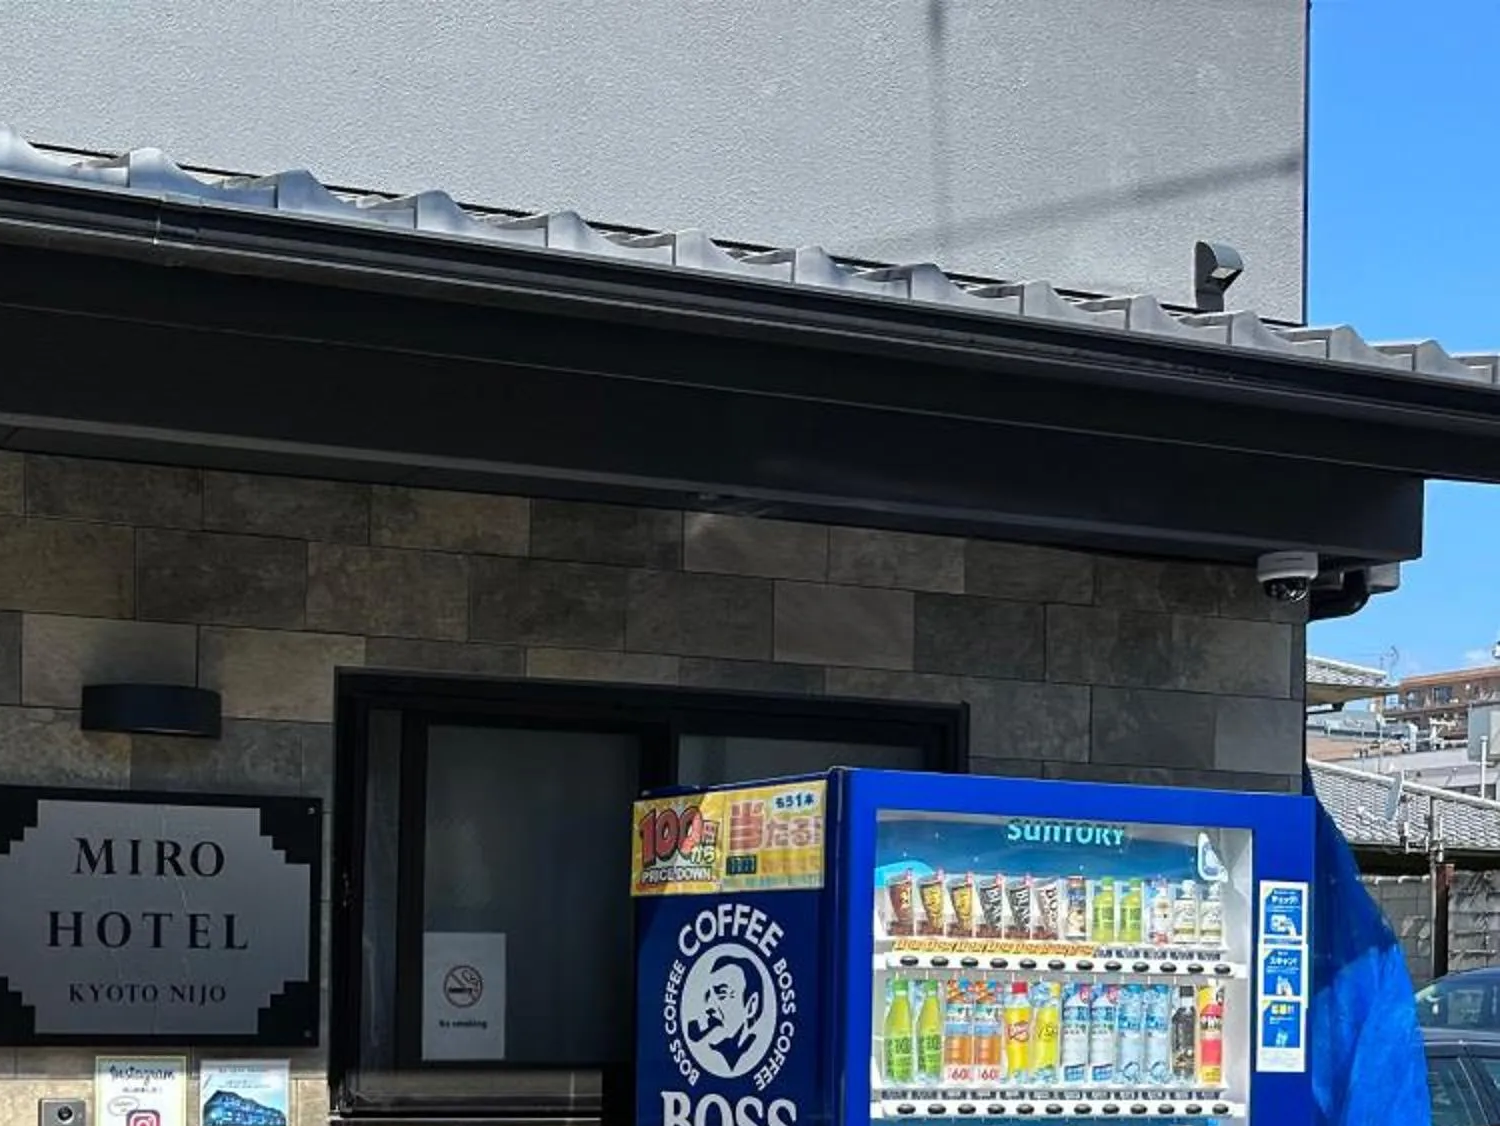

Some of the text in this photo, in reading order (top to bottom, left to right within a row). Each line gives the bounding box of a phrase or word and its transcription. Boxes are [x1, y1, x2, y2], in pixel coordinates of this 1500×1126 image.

[72, 837, 224, 877] MIRO
[642, 868, 674, 884] PRICE
[675, 866, 712, 882] DOWN
[47, 911, 249, 950] HOTEL
[678, 903, 784, 957] COFFEE
[69, 983, 226, 1006] KYOTO NIJO
[663, 959, 700, 1087] BOSS COFFEE
[753, 957, 796, 1091] BOSS COFFEE
